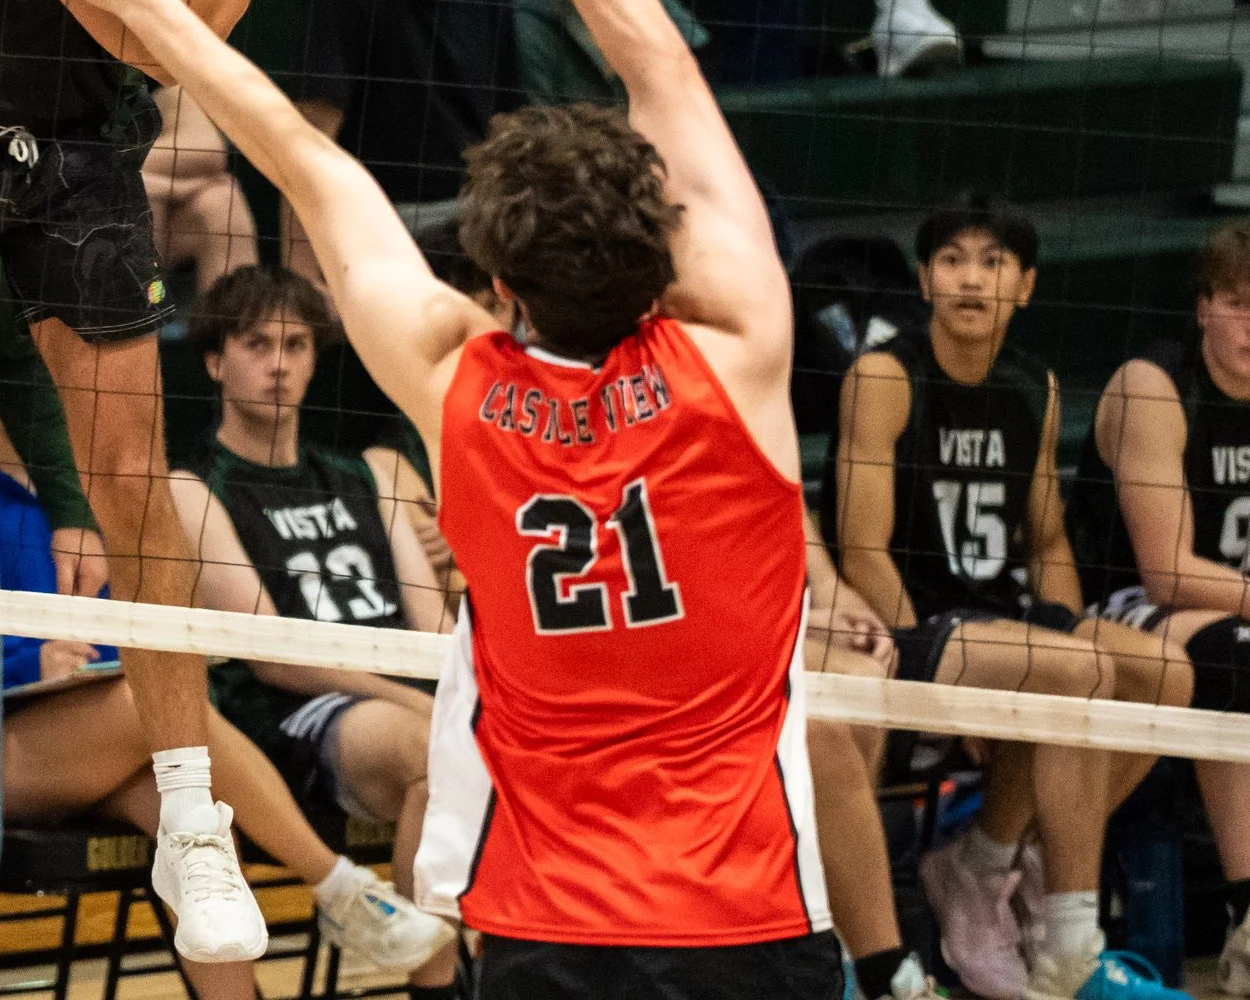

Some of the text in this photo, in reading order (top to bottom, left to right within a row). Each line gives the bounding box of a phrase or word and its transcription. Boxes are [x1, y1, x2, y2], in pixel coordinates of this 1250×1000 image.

[939, 427, 1007, 468] VISTA
[263, 497, 358, 540] VISTA
[515, 476, 686, 636] 21
[932, 478, 1008, 580] 15
[285, 545, 398, 622] 13
